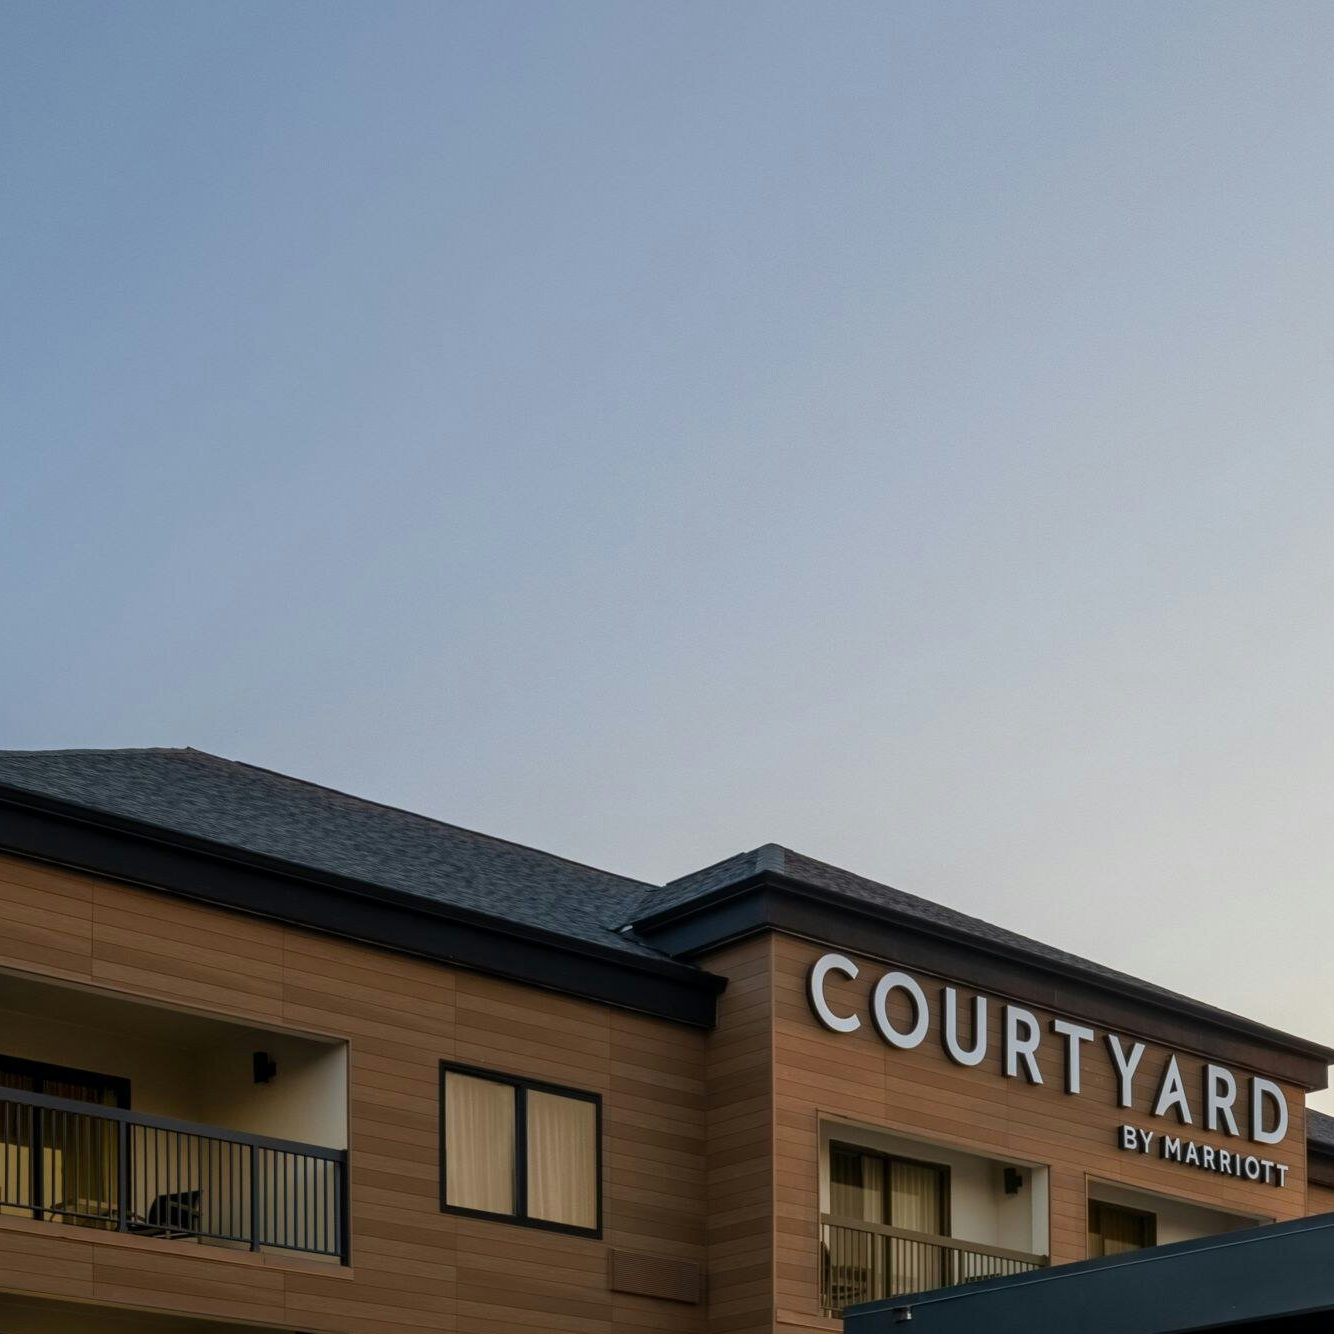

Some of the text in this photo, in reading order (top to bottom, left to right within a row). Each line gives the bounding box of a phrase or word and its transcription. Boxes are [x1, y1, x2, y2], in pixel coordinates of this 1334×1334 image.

[808, 953, 1289, 1145] COURTYARD
[1122, 1125, 1289, 1188] BY MARRIOTT
